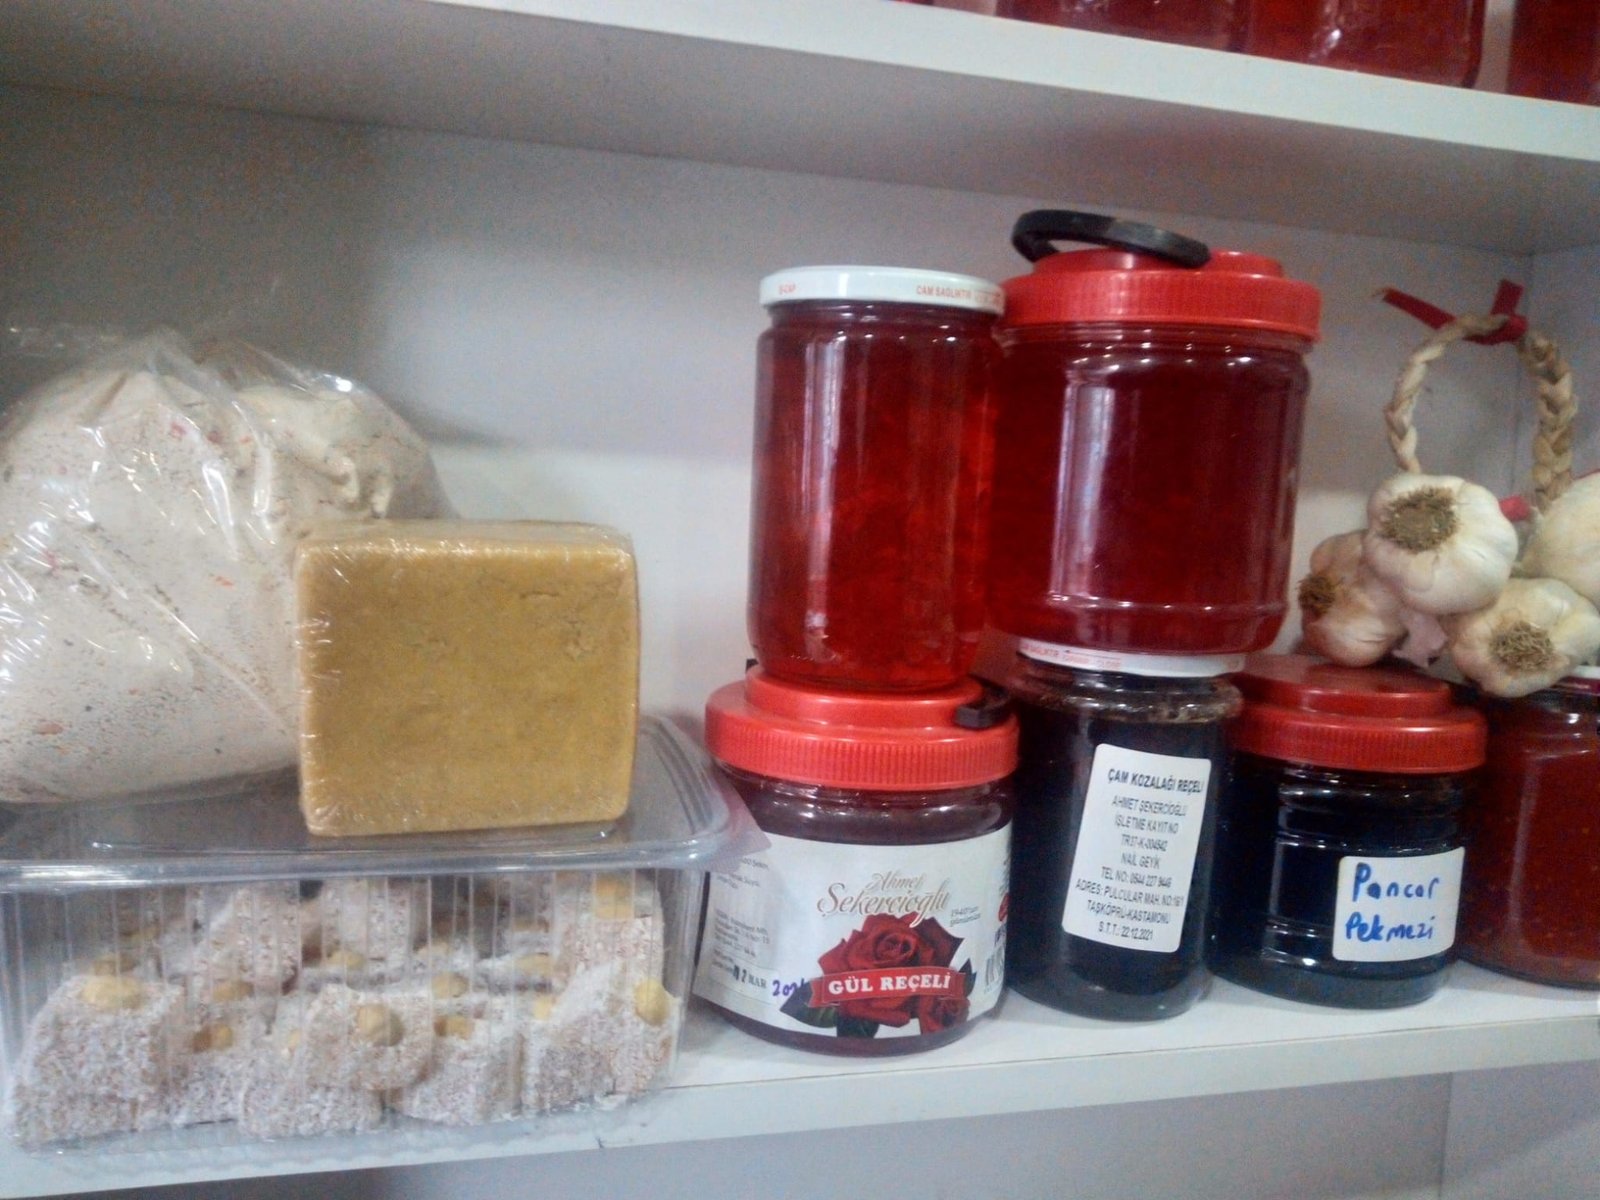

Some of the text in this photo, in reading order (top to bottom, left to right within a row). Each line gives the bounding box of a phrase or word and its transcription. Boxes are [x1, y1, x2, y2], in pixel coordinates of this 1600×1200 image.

[1108, 768, 1128, 784] ÇAM
[1131, 773, 1175, 791] KOZALAĞI
[1112, 794, 1138, 810] AHMET
[1115, 814, 1146, 831] İŞLETME
[1121, 852, 1161, 869] NAİL GEYİK
[866, 870, 928, 891] Ahmet
[1102, 866, 1114, 880] TEL
[1115, 868, 1128, 882] NO:
[1352, 862, 1439, 902] Pancar
[1075, 878, 1103, 895] ADRES:
[1104, 885, 1143, 904] PULCULAR
[1345, 911, 1435, 942] Pekmezi
[828, 971, 951, 995] GÜL REÇELİ
